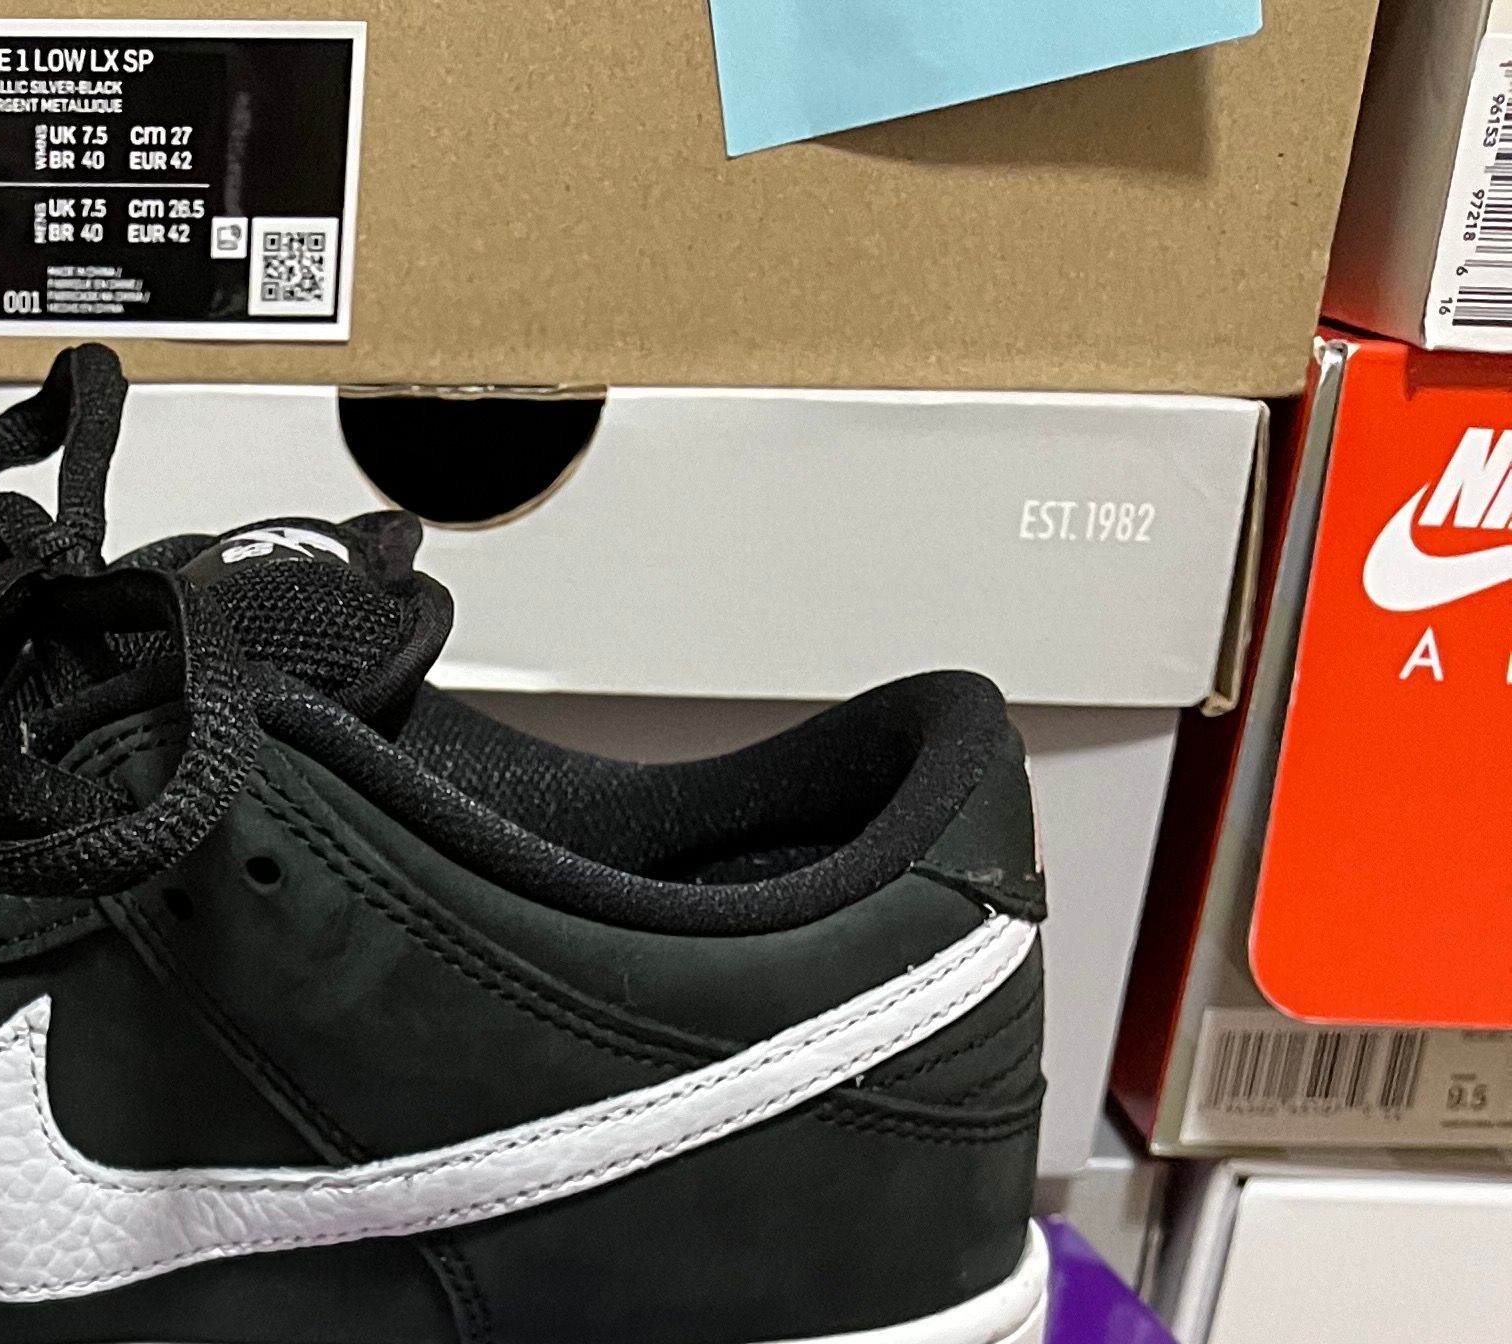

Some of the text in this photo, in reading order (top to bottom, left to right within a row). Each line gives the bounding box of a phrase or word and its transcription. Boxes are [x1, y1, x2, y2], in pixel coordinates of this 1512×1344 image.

[16, 49, 29, 72] 1
[34, 49, 85, 73] LOW
[90, 49, 119, 73] LX
[123, 49, 154, 73] SP
[29, 80, 123, 95] SILVER-BLACK
[49, 125, 76, 145] UK
[81, 125, 108, 145] 7.5
[170, 126, 193, 145] 27
[49, 151, 193, 170] BR 40 EUR 42
[48, 199, 75, 218] UK
[80, 199, 107, 218] 7.5
[168, 200, 205, 219] 26.5
[1438, 92, 1507, 316] 96153 97218 6 16
[48, 223, 191, 243] BR 40 EUR 42
[3, 290, 42, 314] 001
[1019, 499, 1156, 542] EST. 1982
